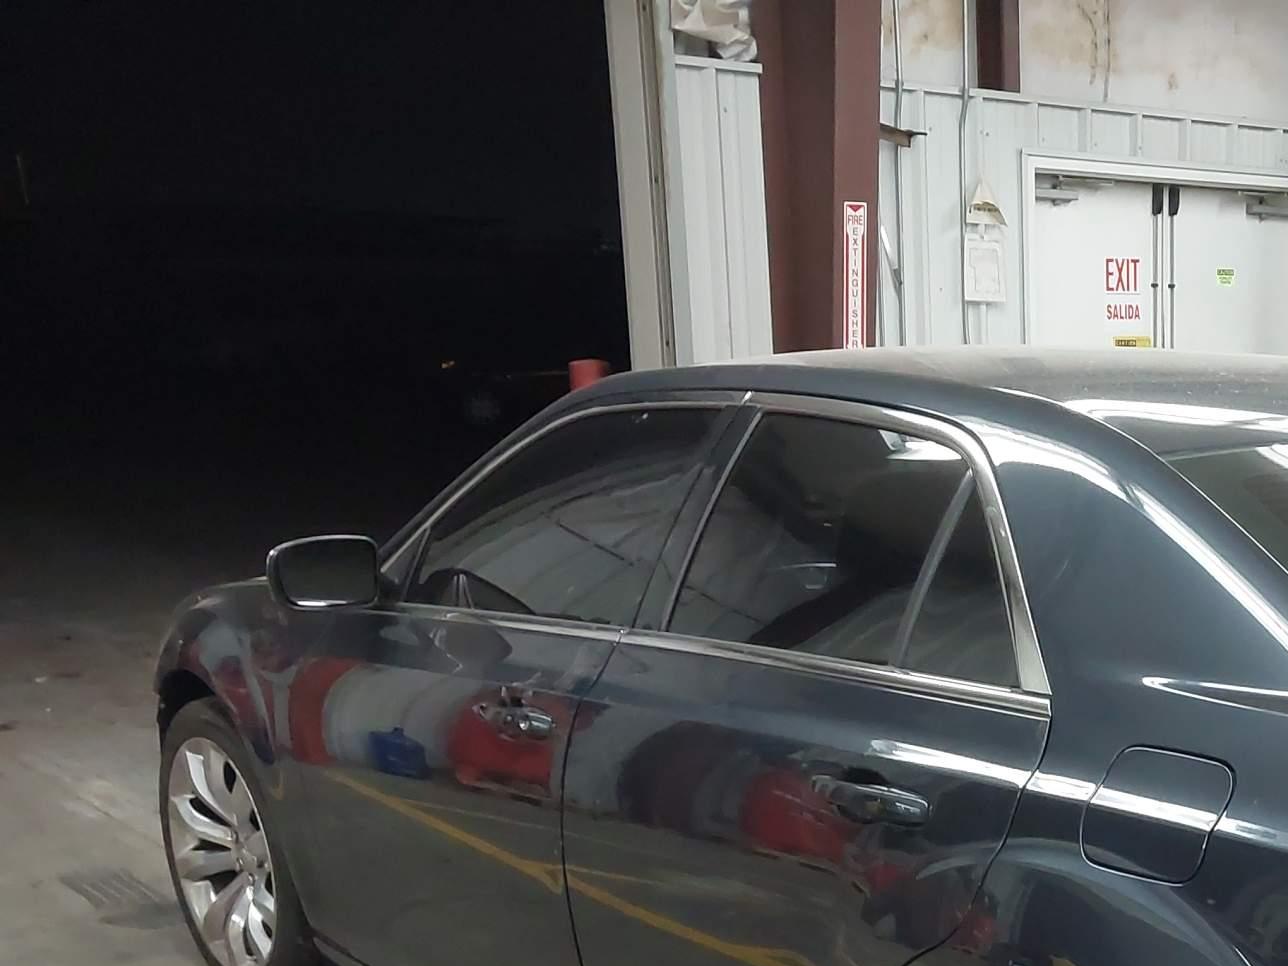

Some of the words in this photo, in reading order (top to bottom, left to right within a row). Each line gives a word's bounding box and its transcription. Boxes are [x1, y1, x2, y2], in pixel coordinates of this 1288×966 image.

[847, 214, 863, 226] FIRE
[1105, 258, 1140, 292] EXIT
[1106, 303, 1141, 321] SALIDA
